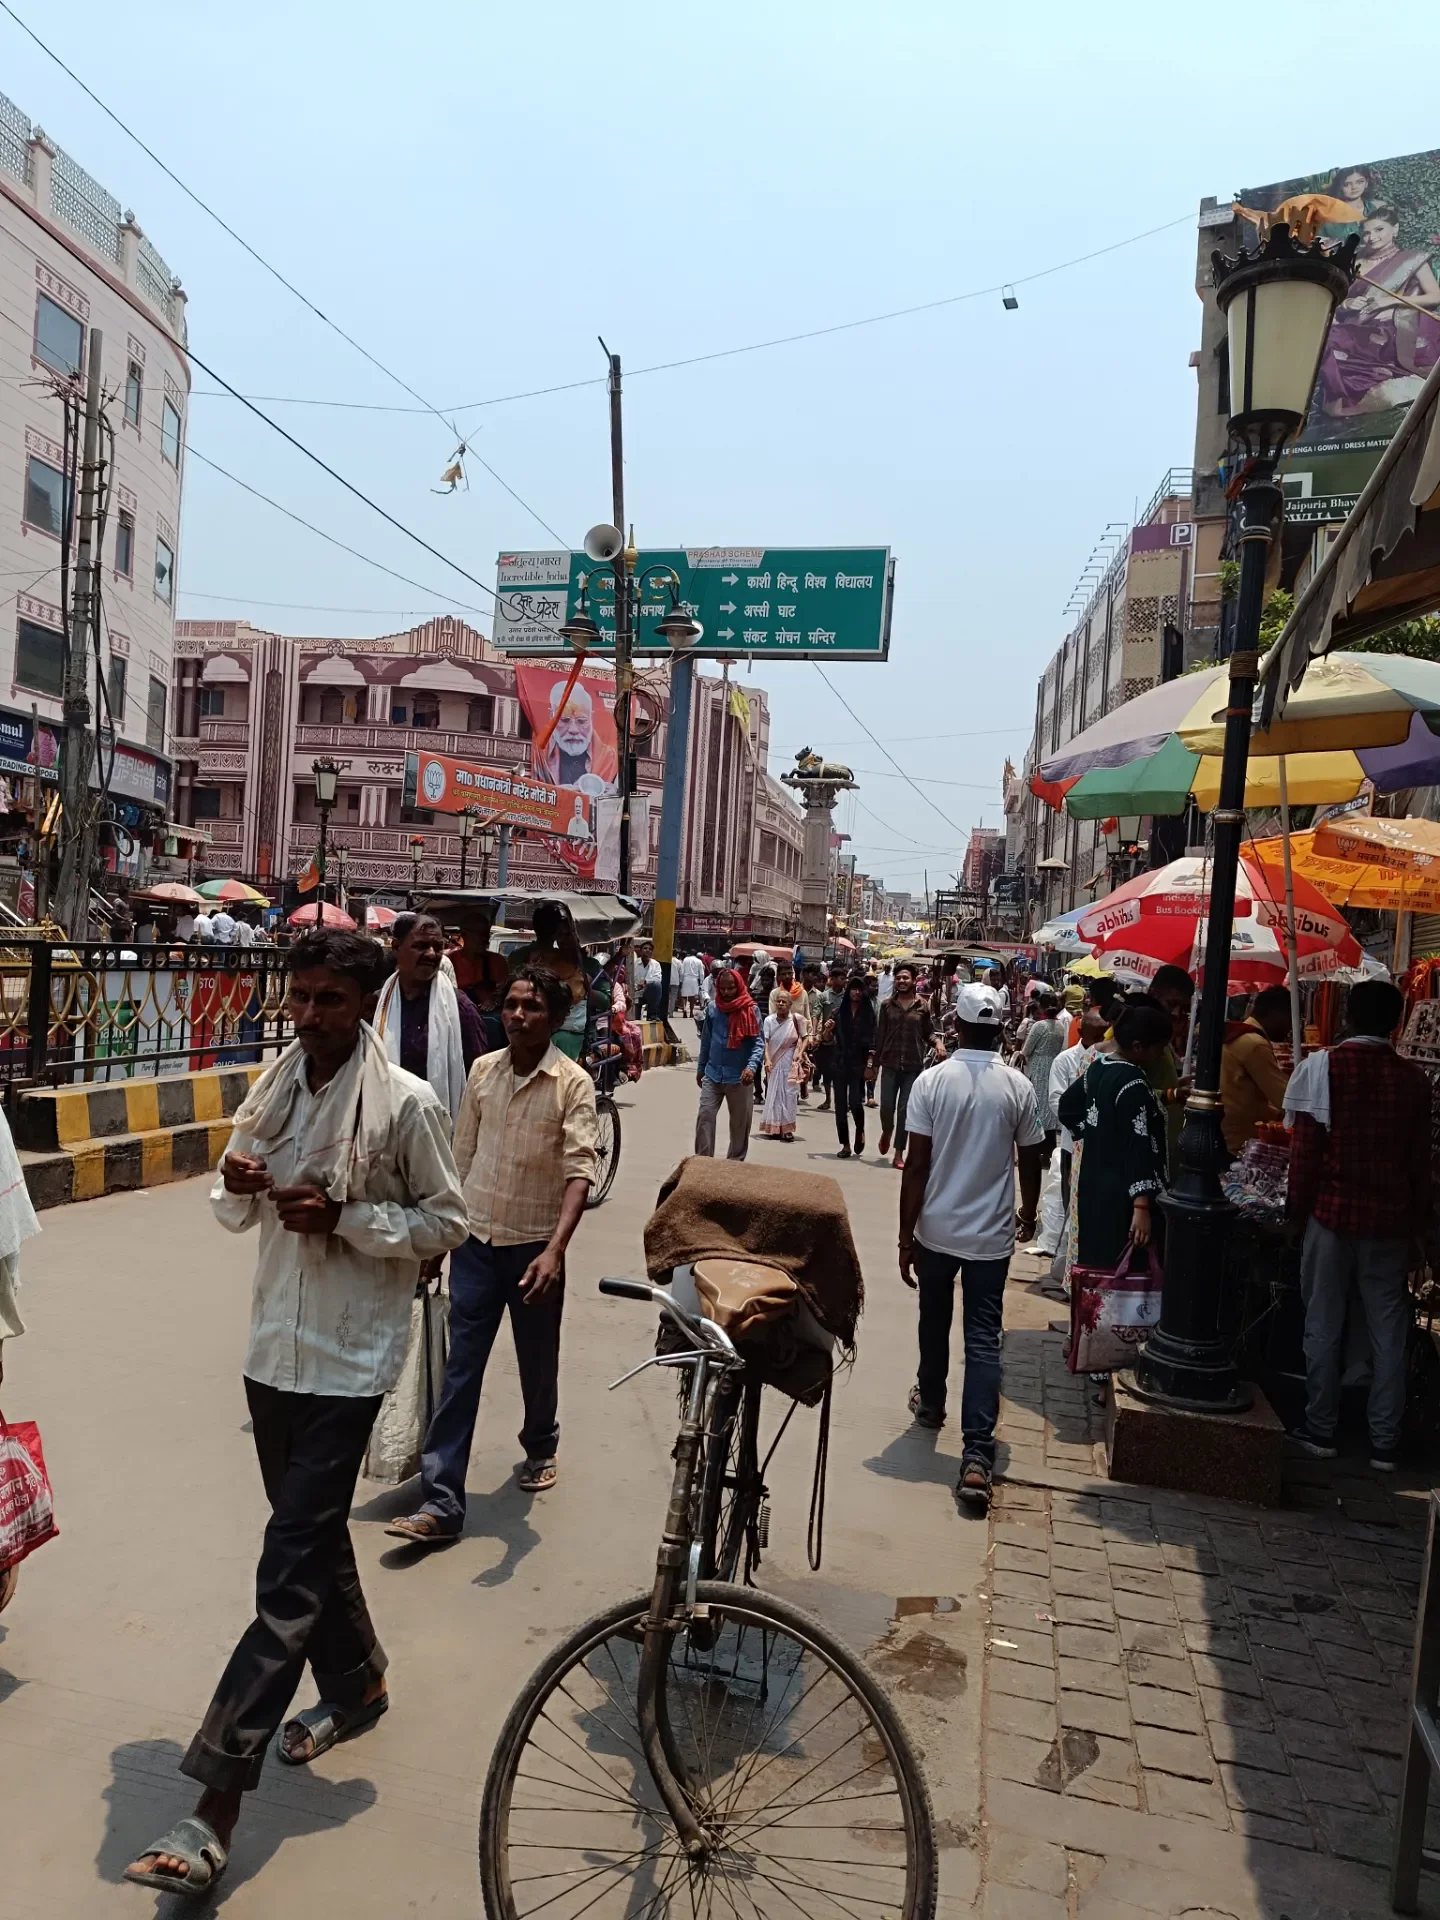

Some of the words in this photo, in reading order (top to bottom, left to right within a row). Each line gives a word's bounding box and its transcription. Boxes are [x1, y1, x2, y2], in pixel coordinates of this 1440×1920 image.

[1317, 443, 1340, 452] GOWN
[1344, 440, 1365, 449] DRESS
[1285, 501, 1327, 513] Jaipuria
[1330, 498, 1357, 508] Bhaw
[1174, 525, 1190, 543] P
[728, 550, 763, 558] SCHEME
[501, 572, 543, 582] Incredible
[747, 571, 771, 589] काशी
[776, 572, 798, 593] हिन्दू
[804, 572, 827, 589] विश्व
[835, 572, 873, 589] विद्यालय
[743, 601, 770, 617] अस्सी
[778, 605, 796, 617] घाट
[743, 628, 768, 644] संकट
[775, 627, 801, 644] मोचन
[807, 627, 836, 645] मन्दिर
[0, 723, 23, 738] mul
[474, 774, 511, 795] प्रधानमंत्री
[512, 782, 529, 800] नरेंद्र
[530, 785, 547, 804] मोदी
[547, 789, 557, 806] जी
[1344, 796, 1369, 812] 2024
[1156, 905, 1172, 914] Bus
[200, 977, 215, 989] STO
